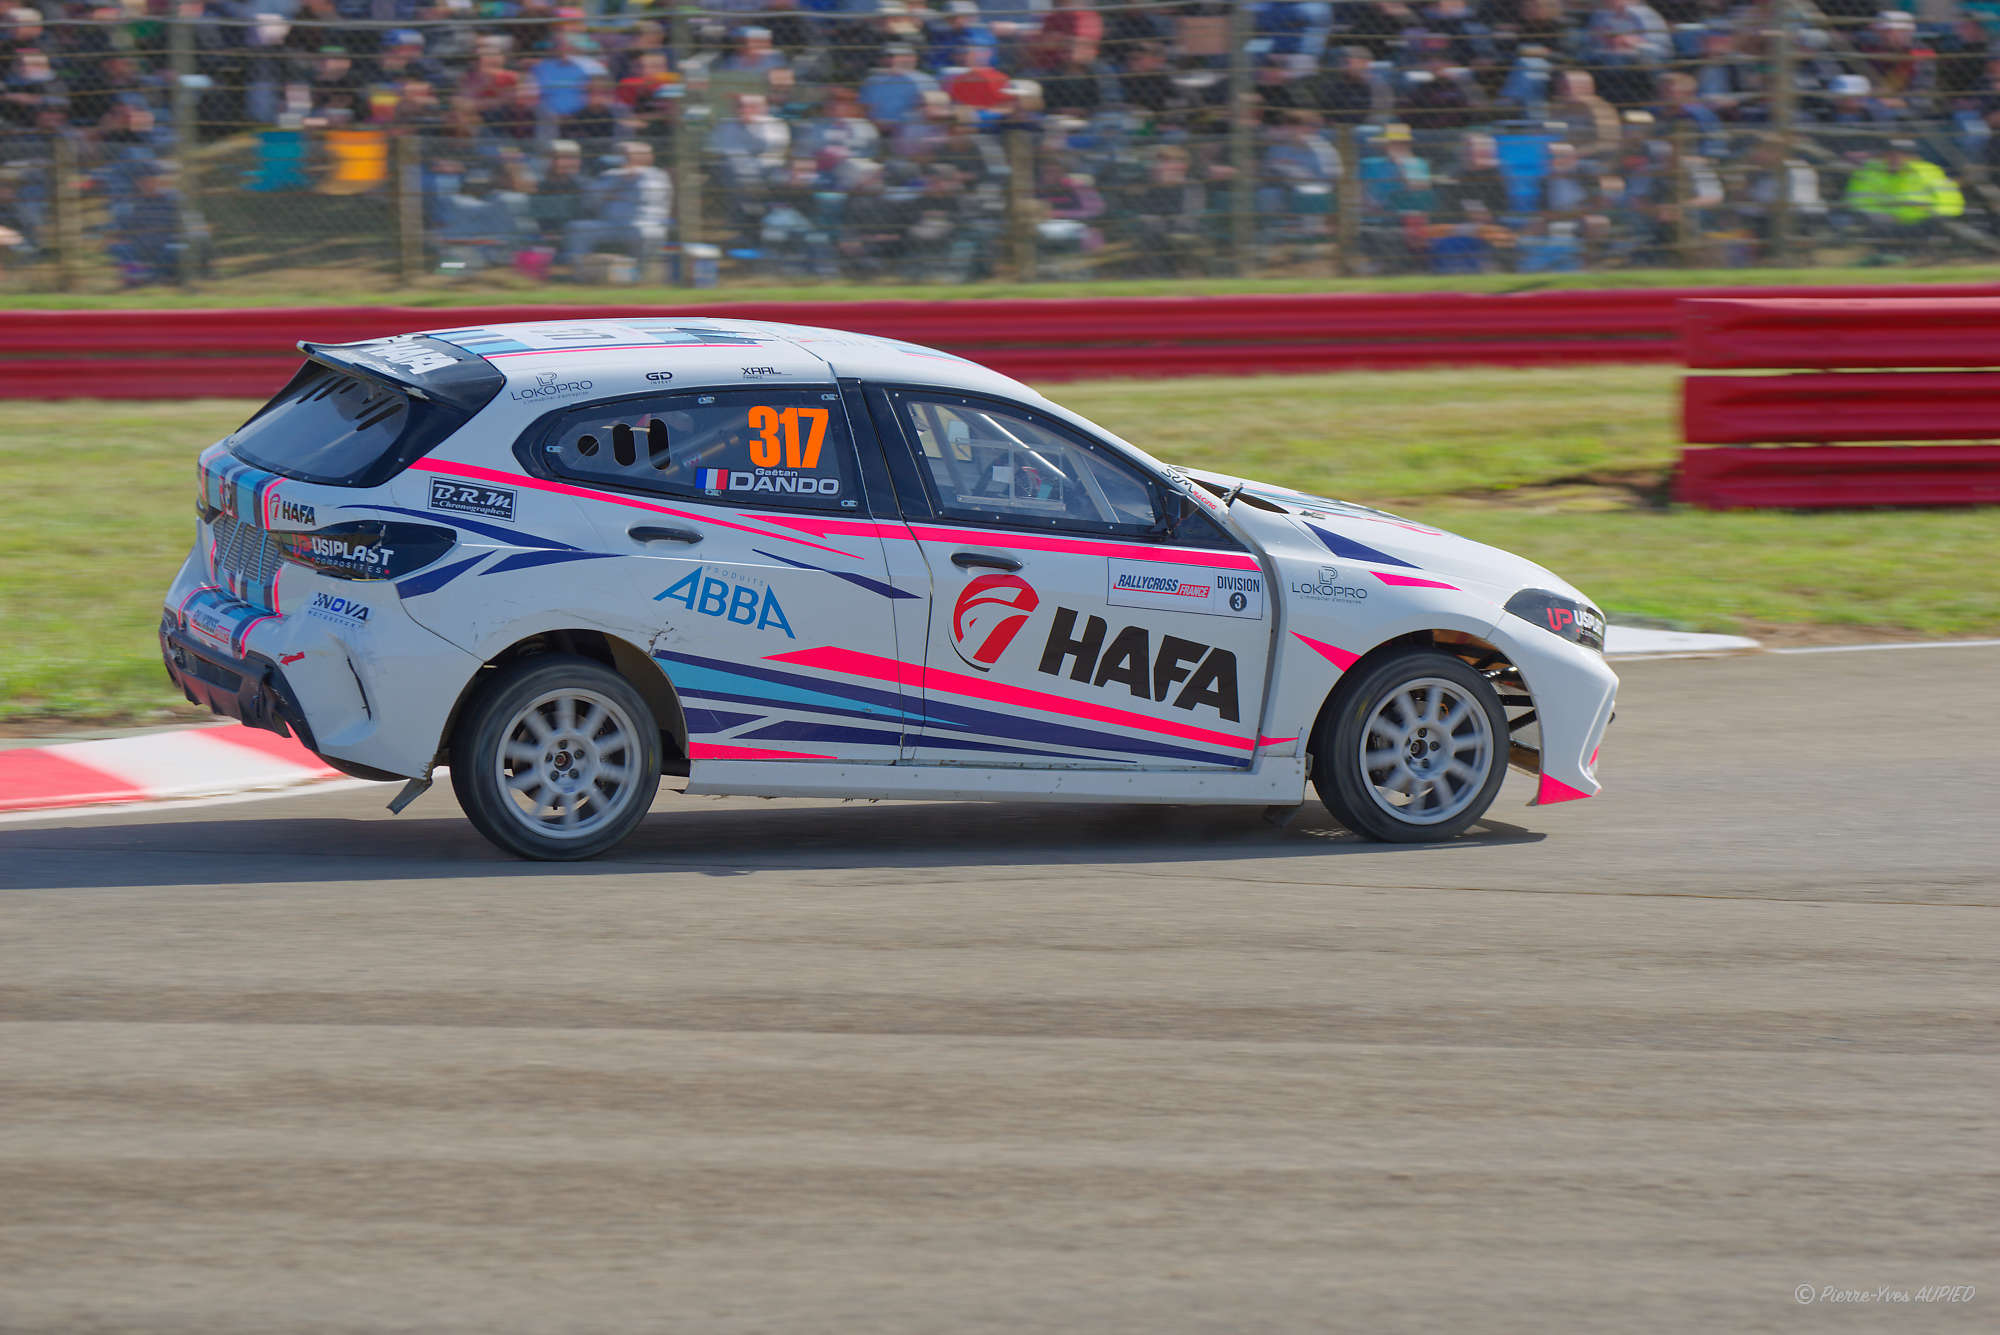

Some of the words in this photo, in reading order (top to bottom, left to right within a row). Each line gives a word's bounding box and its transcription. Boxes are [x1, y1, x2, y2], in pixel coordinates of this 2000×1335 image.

[645, 371, 673, 381] GD
[511, 380, 593, 400] LOKOPRO
[748, 405, 829, 468] 317
[729, 471, 840, 495] DANDO
[755, 468, 798, 477] Gaëtan
[282, 501, 316, 526] HAFA
[311, 537, 394, 566] USIPLAST
[1117, 574, 1179, 592] RALLYCROSS
[1178, 584, 1210, 598] FRANCE
[1217, 576, 1260, 592] DIVISION
[1292, 582, 1368, 599] LOKOPRO
[652, 566, 796, 639] ABBA
[1233, 595, 1243, 610] 3
[1038, 606, 1240, 723] HAFA
